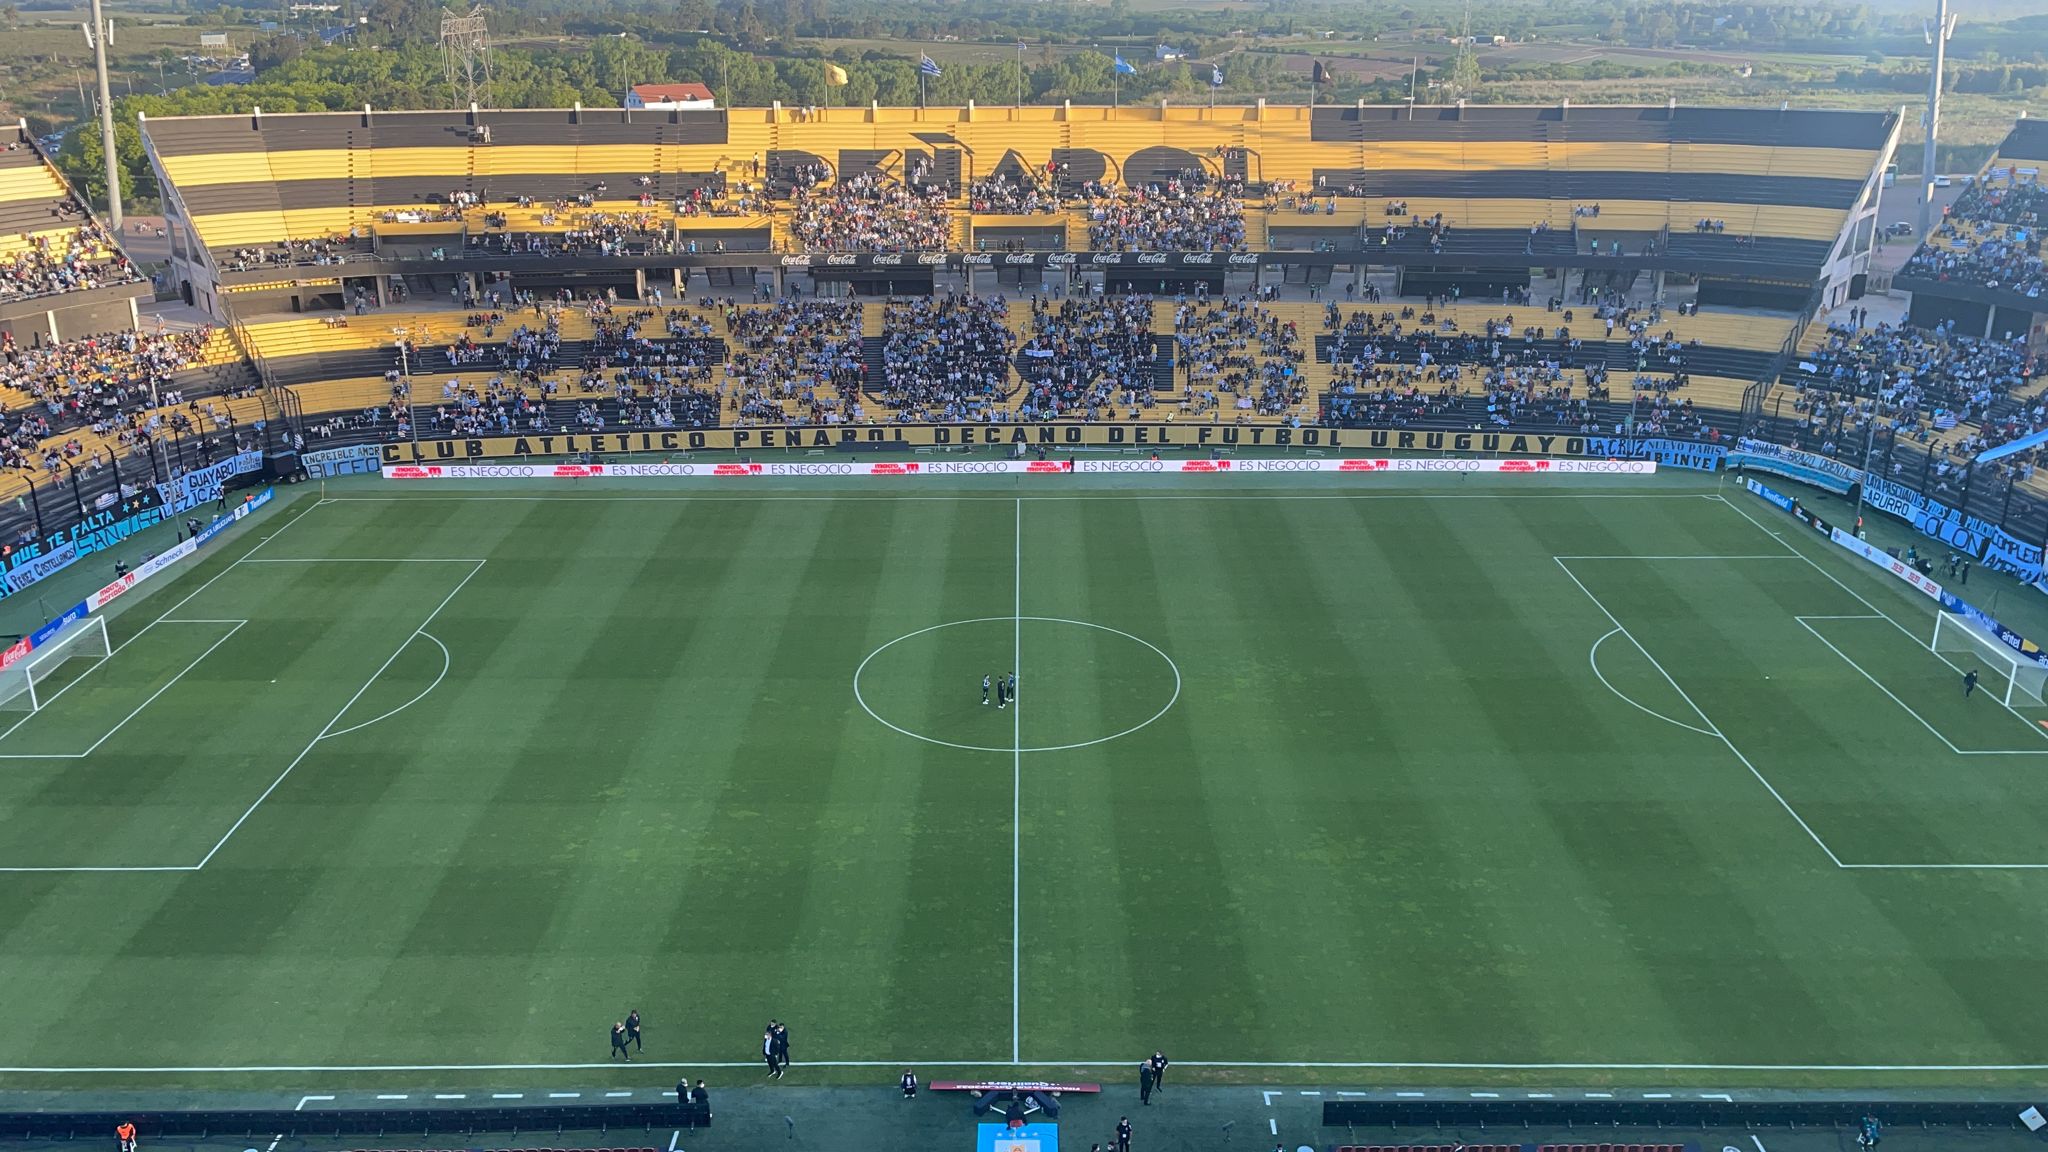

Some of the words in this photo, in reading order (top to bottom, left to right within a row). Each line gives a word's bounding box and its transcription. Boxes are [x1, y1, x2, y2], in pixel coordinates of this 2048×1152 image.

[781, 255, 811, 265] Coca-Cola
[827, 255, 856, 265] Coca-Cola
[873, 255, 901, 265] Coca-Cola
[918, 254, 947, 264] Coca-Cola
[963, 253, 992, 264] Coca-Cola
[1005, 253, 1035, 264] Coca-Cola
[1048, 253, 1077, 264] Coca-Cola
[1092, 253, 1121, 264] Coca-Cola
[1137, 253, 1167, 264] Coca-Cola
[1183, 253, 1212, 264] Coca-Cola
[1229, 253, 1259, 264] Coca-Cola
[382, 440, 483, 462] CLUB
[514, 432, 705, 454] ATLETICO
[935, 427, 1081, 443] DECANO
[1109, 427, 1169, 443] DEL
[1199, 427, 1342, 446] FUTBOL
[1370, 430, 1584, 455] URUGUAYO
[1648, 440, 1684, 451] NUEVO
[1688, 444, 1721, 455] PARIS
[302, 448, 354, 464] INCREIBLE
[358, 445, 379, 456] AMOR
[1084, 461, 1098, 471] ES
[1102, 461, 1163, 472] NEGOCIO
[1240, 461, 1253, 471] ES
[1257, 460, 1320, 471] NEGOCIO
[1398, 461, 1412, 471] ES
[1416, 461, 1480, 471] NEGOCIO
[1674, 453, 1711, 469] INVE
[451, 466, 464, 477] ES
[466, 466, 534, 477] NEGOCIO
[612, 465, 628, 475] ES
[631, 464, 694, 475] NEGOCIO
[771, 464, 785, 474] ES
[788, 464, 852, 474] NEGOCIO
[928, 462, 942, 472] ES
[946, 462, 1007, 473] NEGOCIO
[1559, 461, 1573, 471] ES
[1577, 461, 1643, 473] NEGOCIO
[188, 462, 234, 488] GUAYABO
[250, 490, 271, 511] Tenfield
[1764, 488, 1789, 508] Tenfield
[1862, 487, 1909, 516] CAPURRO
[11, 543, 42, 568] QUE
[47, 531, 65, 550] TE
[70, 510, 115, 539] FALTA
[1914, 511, 1979, 559] COLON
[155, 547, 183, 569] Schneck
[10, 570, 36, 590] PEREZ
[98, 585, 126, 605] mercado
[99, 582, 119, 597] macro
[2001, 630, 2020, 649] antel
[3, 639, 27, 665] Coca-Cola
